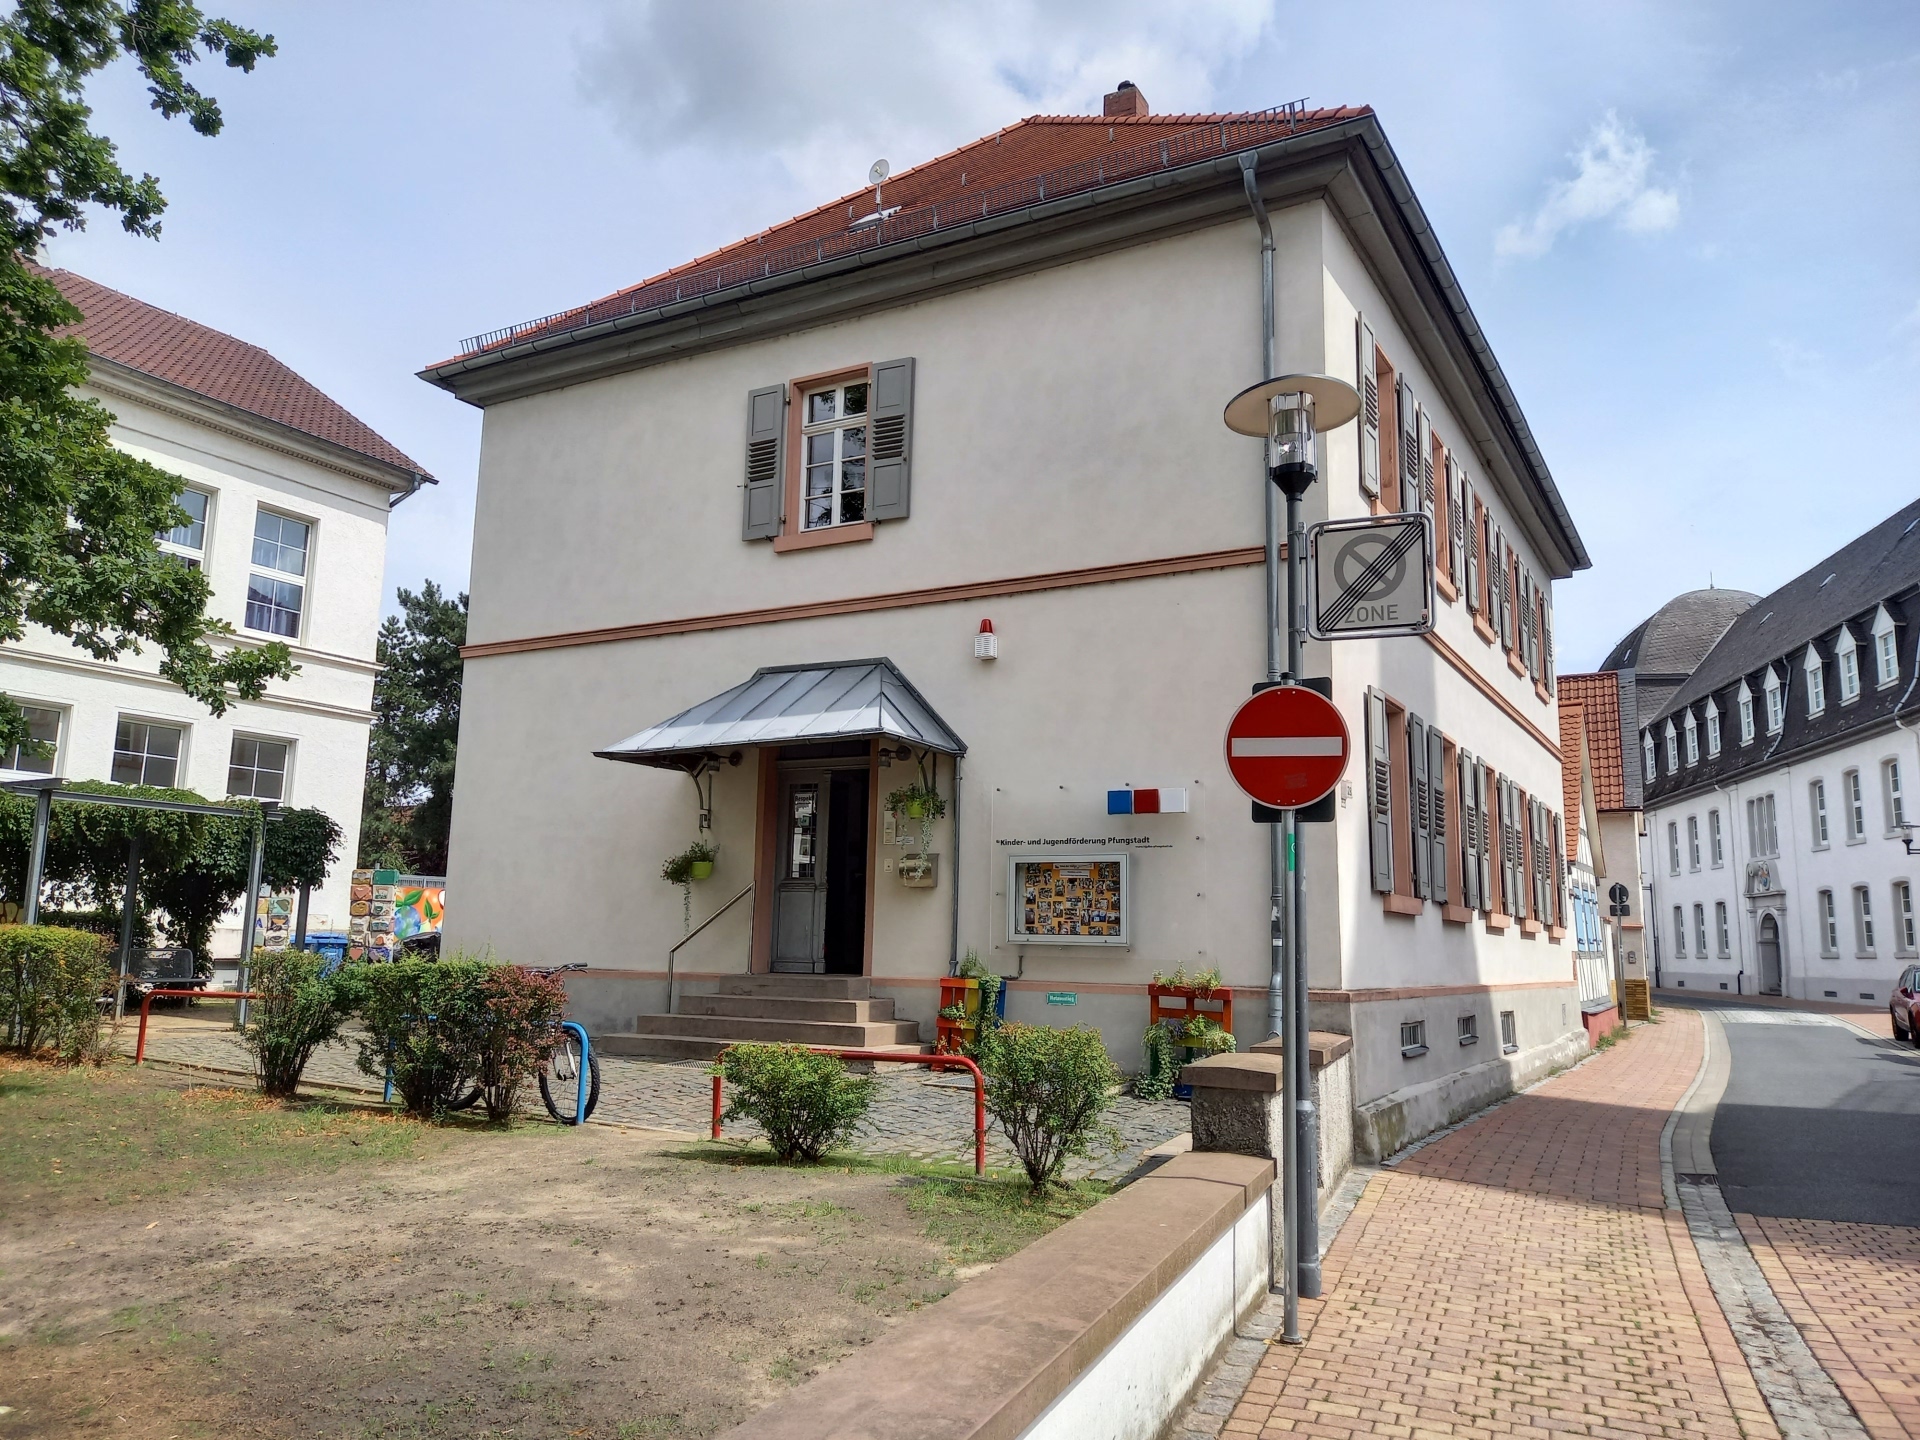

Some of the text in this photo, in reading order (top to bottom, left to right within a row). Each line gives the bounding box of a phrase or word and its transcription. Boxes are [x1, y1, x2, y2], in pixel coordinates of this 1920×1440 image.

[1344, 604, 1399, 624] ZONE
[1000, 838, 1026, 846] Kinder-
[1042, 837, 1106, 847] Jugendförderung
[1107, 835, 1150, 845] Pfungstadt
